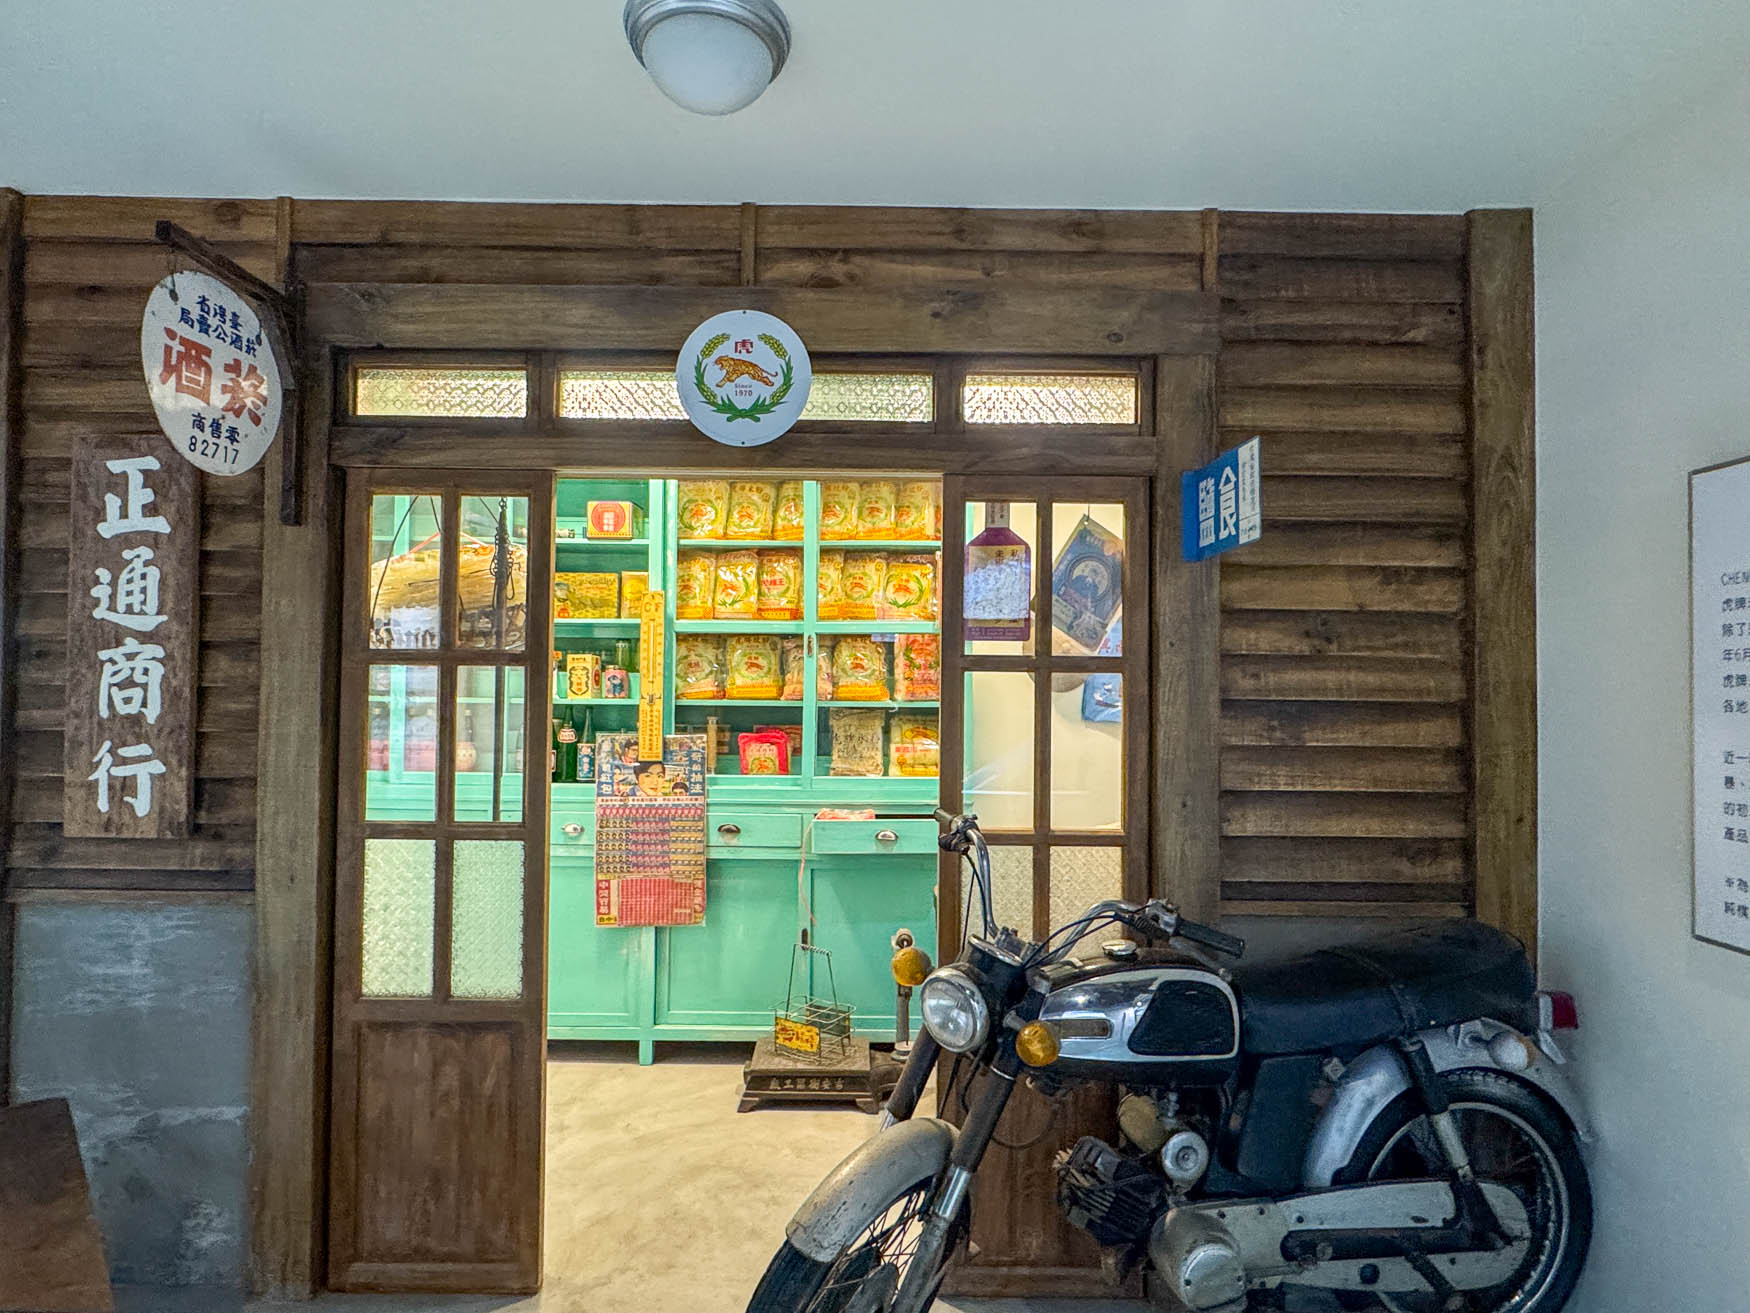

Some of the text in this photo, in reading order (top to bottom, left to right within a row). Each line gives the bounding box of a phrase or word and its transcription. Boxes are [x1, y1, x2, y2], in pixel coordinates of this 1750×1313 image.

[734, 389, 753, 397] 1970
[188, 434, 240, 465] 82717
[1722, 597, 1750, 613] 虎牌
[88, 455, 172, 818] 正通商行
[1722, 622, 1750, 637] 除了
[1723, 673, 1750, 689] 虎牌
